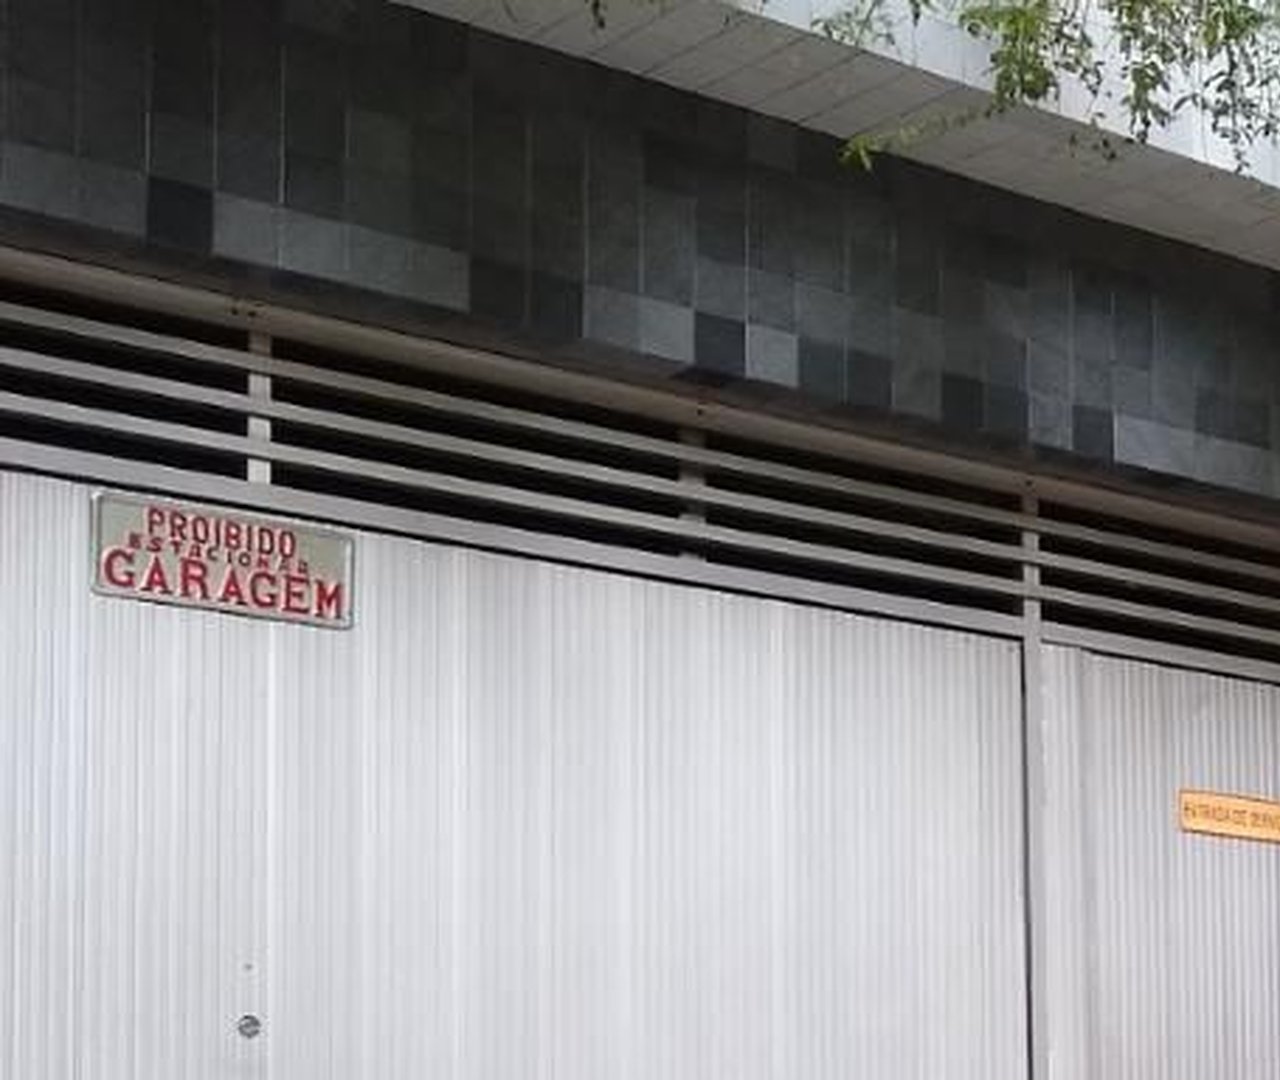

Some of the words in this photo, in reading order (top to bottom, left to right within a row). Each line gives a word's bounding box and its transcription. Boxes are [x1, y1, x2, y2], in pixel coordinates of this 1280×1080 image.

[128, 531, 310, 575] ESTACIONAR
[147, 506, 298, 559] PROIBIDO
[103, 548, 344, 620] GARAGEM
